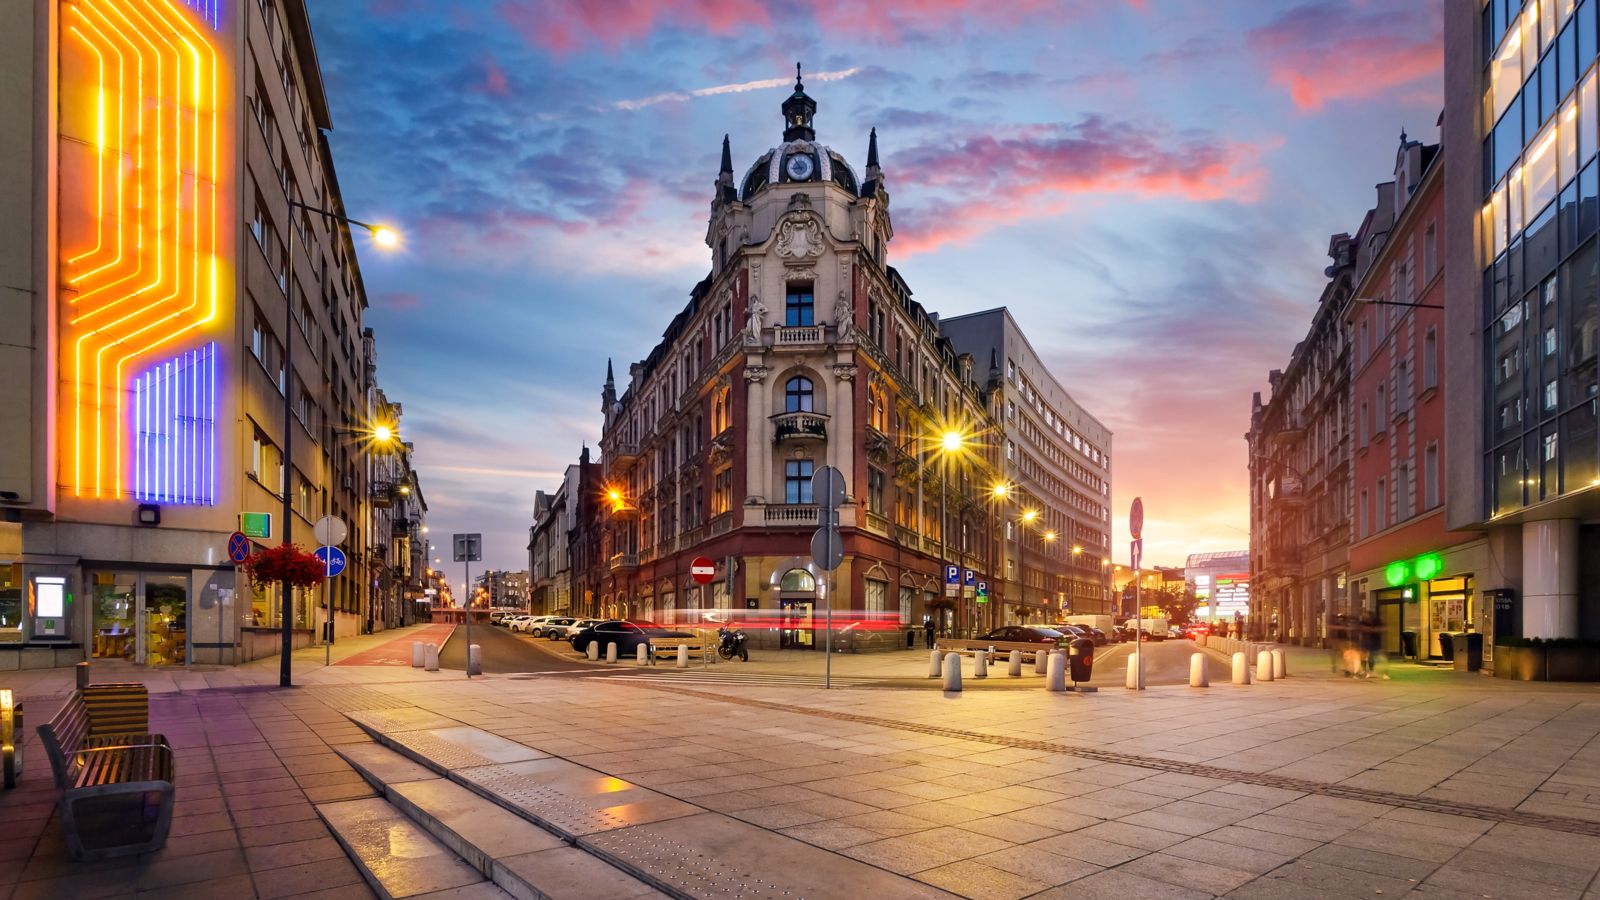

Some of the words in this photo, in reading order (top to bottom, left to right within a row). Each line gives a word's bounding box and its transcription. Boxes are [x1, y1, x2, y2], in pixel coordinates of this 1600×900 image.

[949, 567, 957, 578] P
[966, 570, 973, 581] P
[979, 582, 985, 592] P
